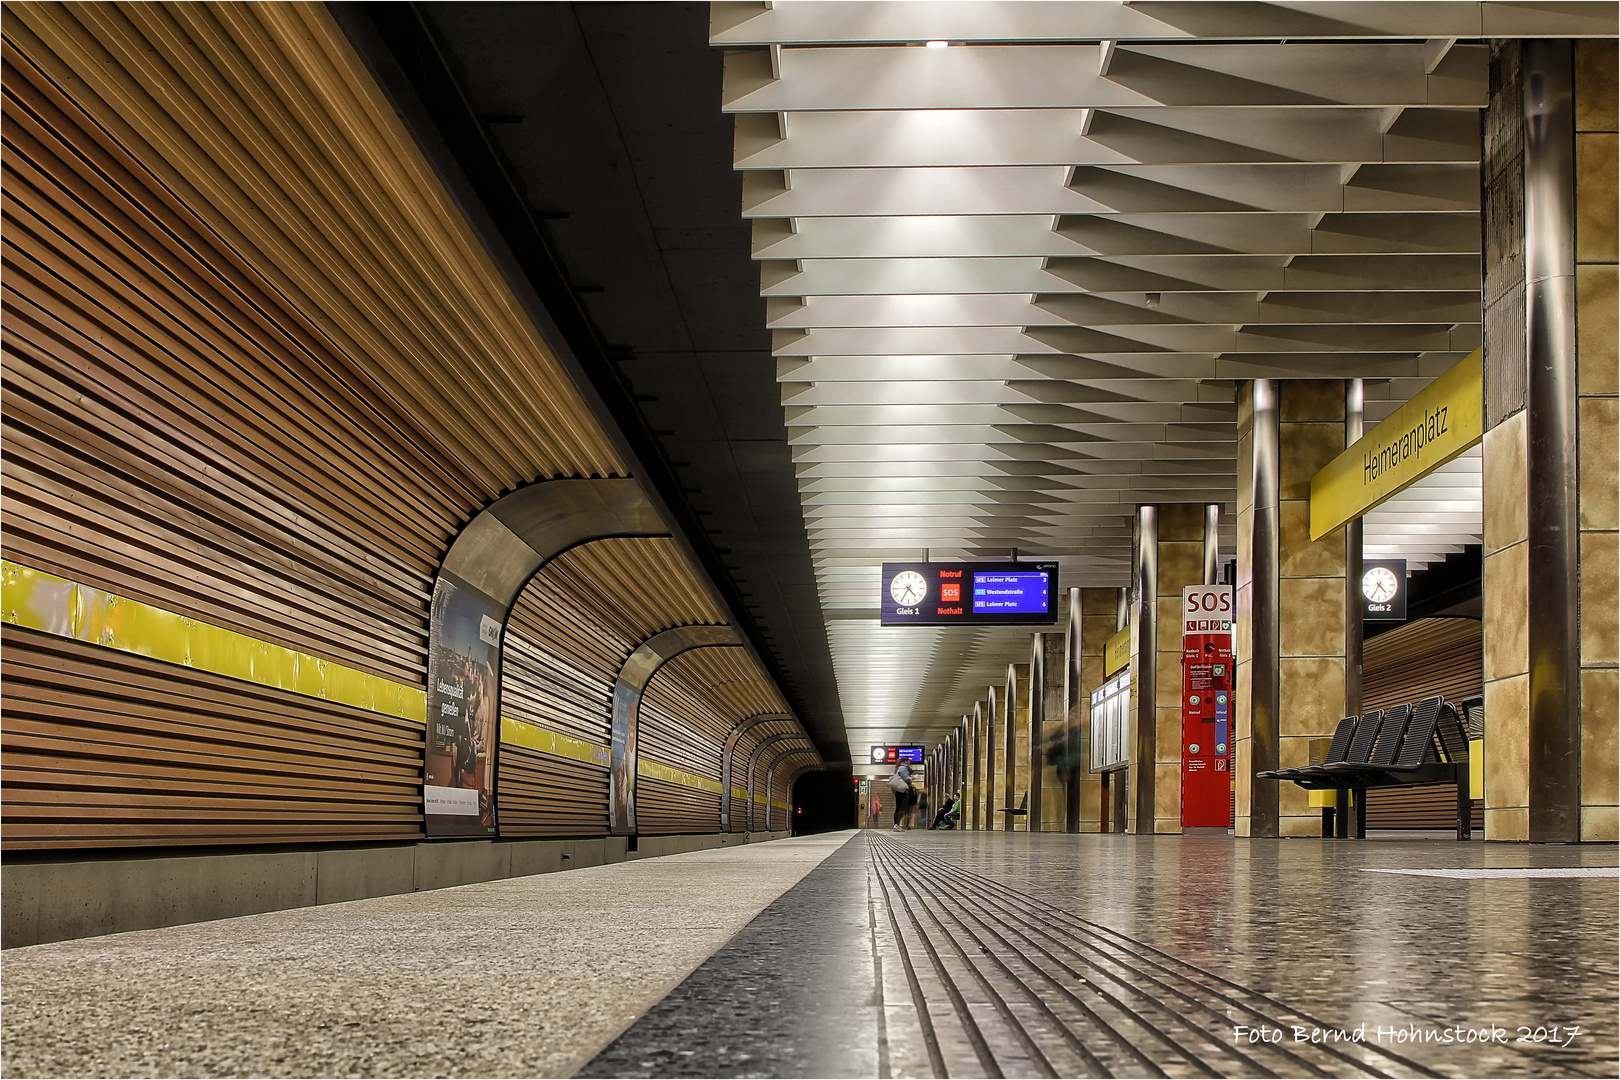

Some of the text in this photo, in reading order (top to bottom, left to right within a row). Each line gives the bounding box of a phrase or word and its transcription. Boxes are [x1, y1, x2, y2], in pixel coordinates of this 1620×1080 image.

[1363, 405, 1449, 486] Heimeranplatz
[940, 570, 962, 578] Notruf
[943, 589, 958, 597] SOS
[1188, 592, 1230, 612] SOS
[896, 607, 920, 615] Gleis 1
[937, 607, 963, 615] Nothalt
[436, 677, 464, 700] Lebensqualität
[441, 700, 459, 717] genießen
